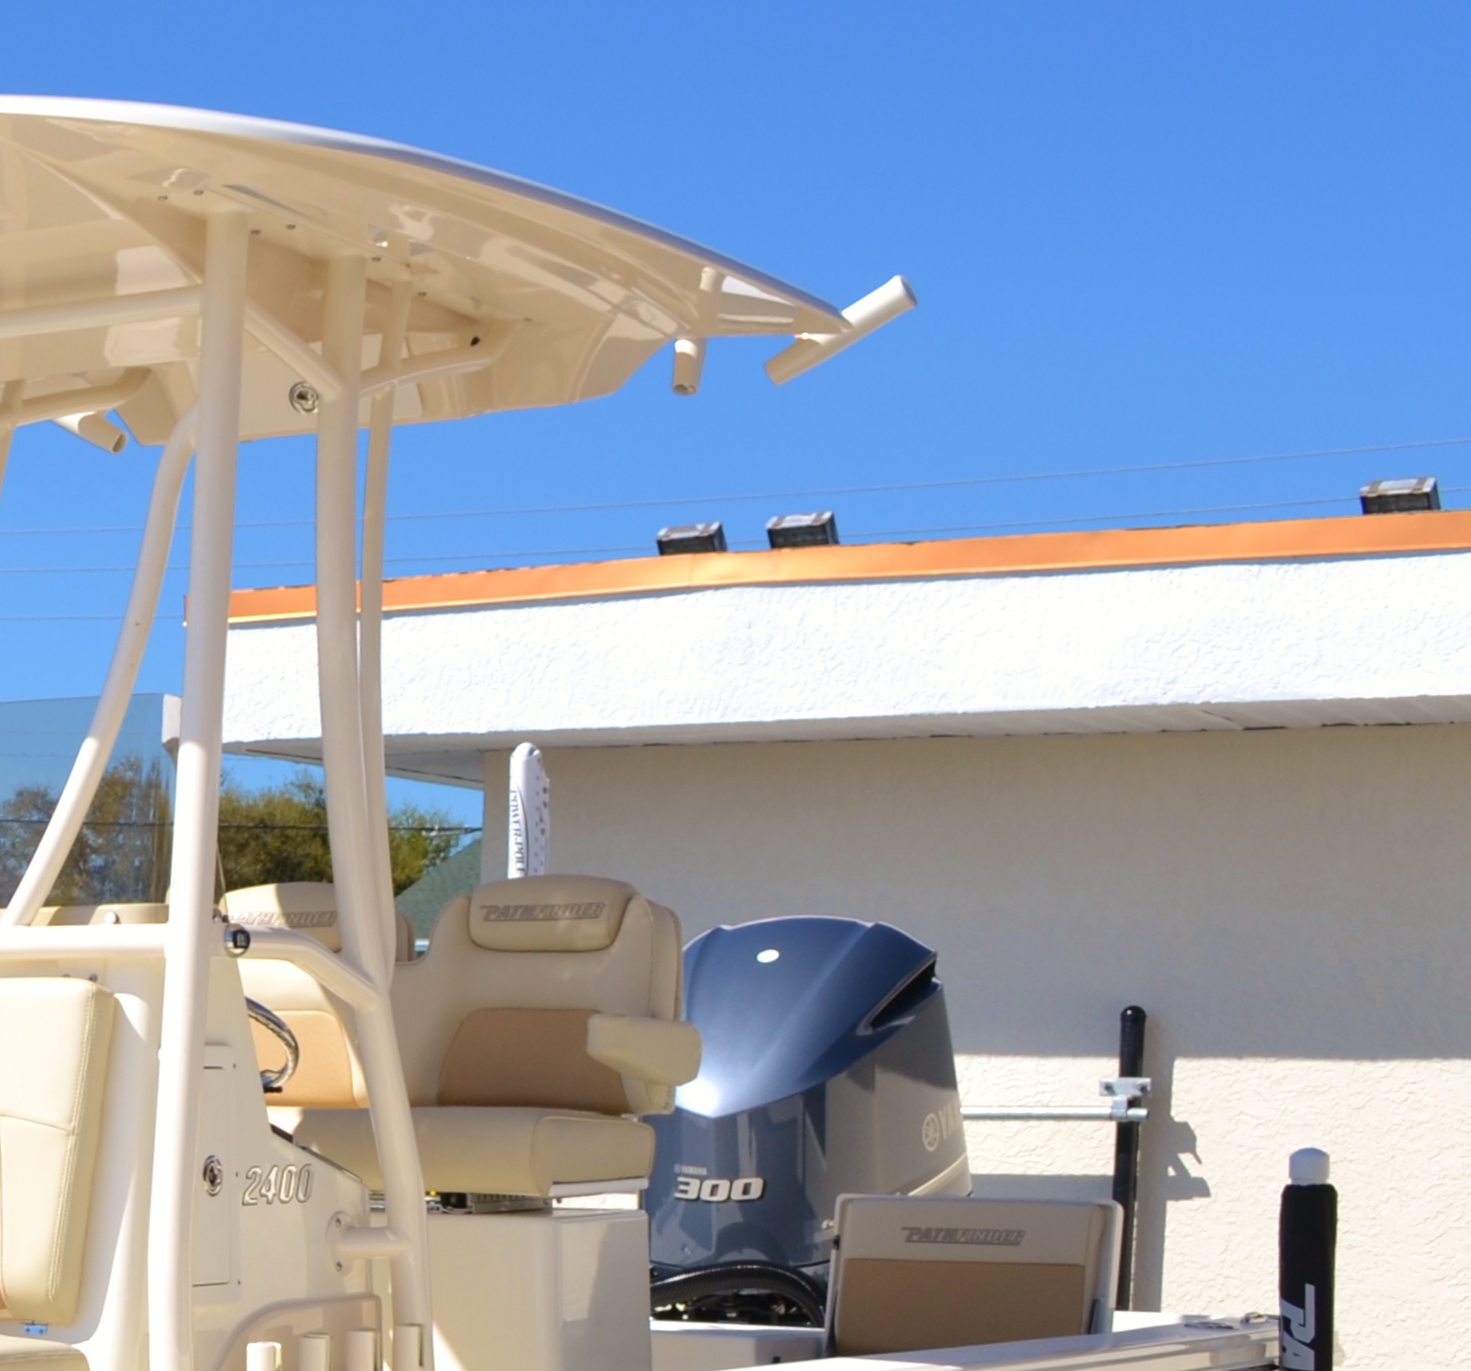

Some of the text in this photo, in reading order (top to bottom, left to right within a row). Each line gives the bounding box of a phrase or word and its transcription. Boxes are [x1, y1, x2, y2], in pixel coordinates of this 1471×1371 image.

[480, 902, 606, 922] PATHFINDER
[241, 1163, 315, 1206] 2400
[673, 1176, 765, 1202] 300
[901, 1226, 1026, 1246] PATHFINDER
